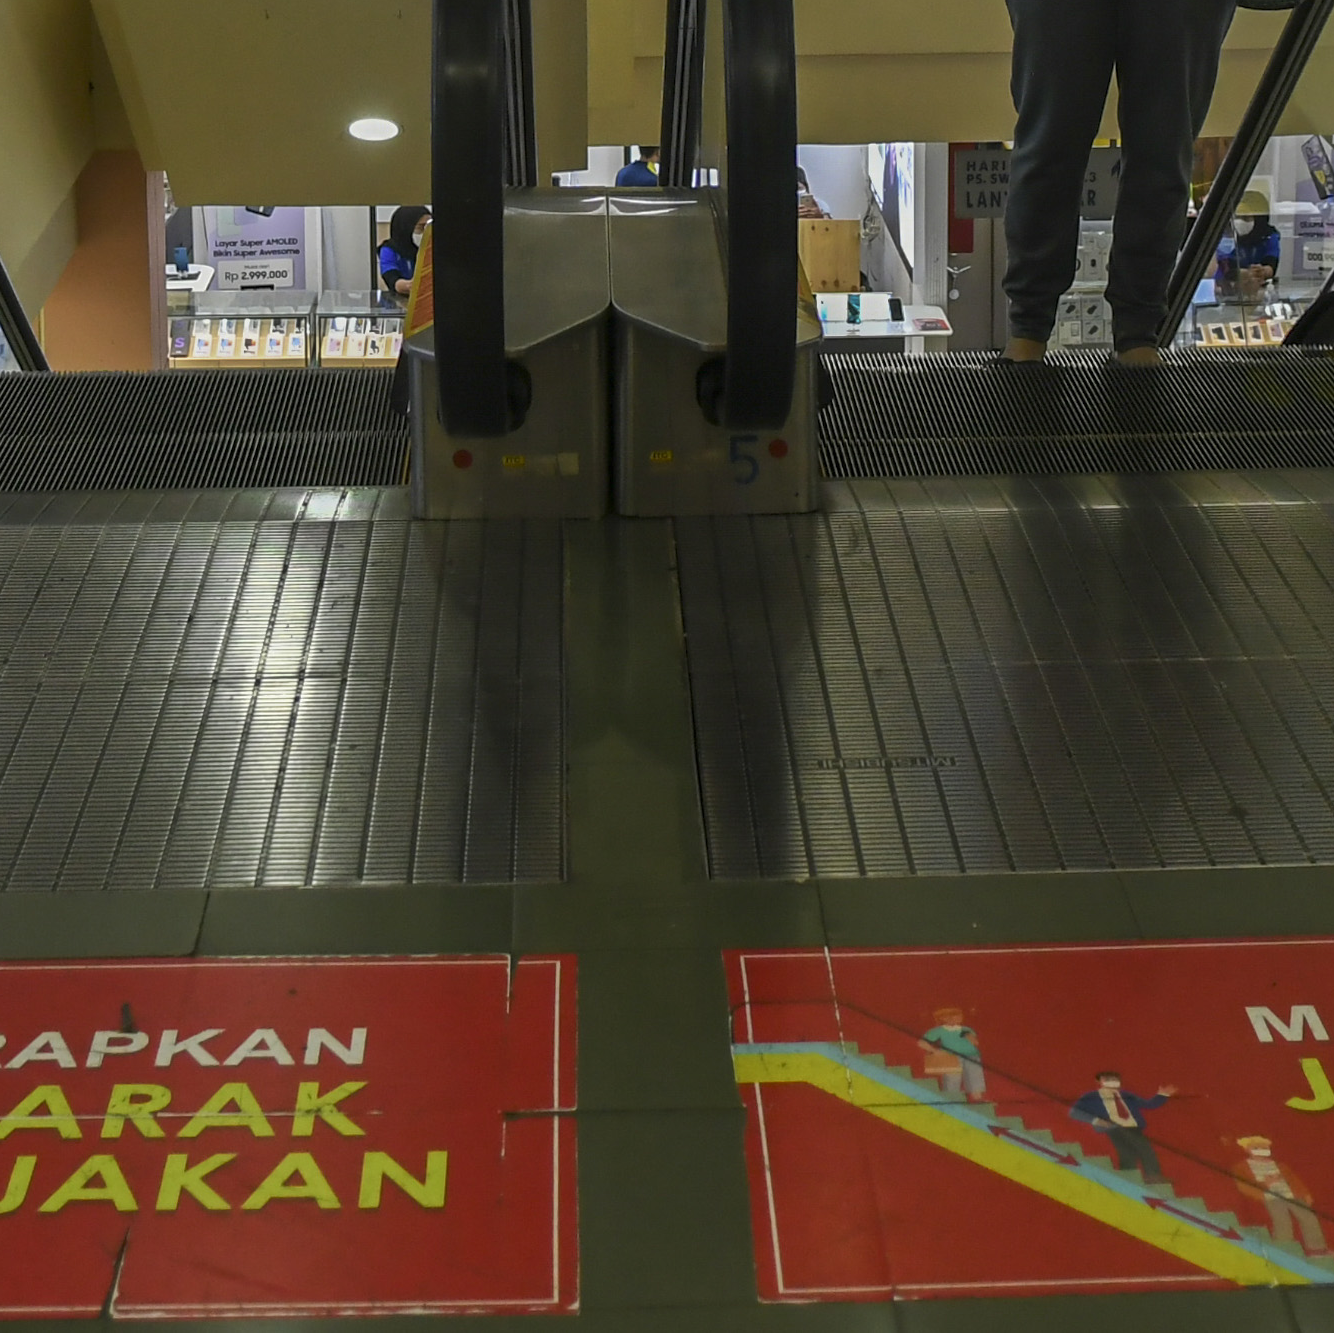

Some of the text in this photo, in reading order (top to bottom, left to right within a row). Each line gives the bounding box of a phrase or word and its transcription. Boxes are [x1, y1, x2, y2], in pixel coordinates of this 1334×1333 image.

[966, 173, 987, 185] PS.
[966, 191, 1008, 209] LAN
[215, 237, 298, 249] Layar Super AMOLED
[213, 248, 300, 259] Bikin Super Awesome
[224, 270, 288, 283] Rp 2.999.000
[729, 434, 760, 484] 5
